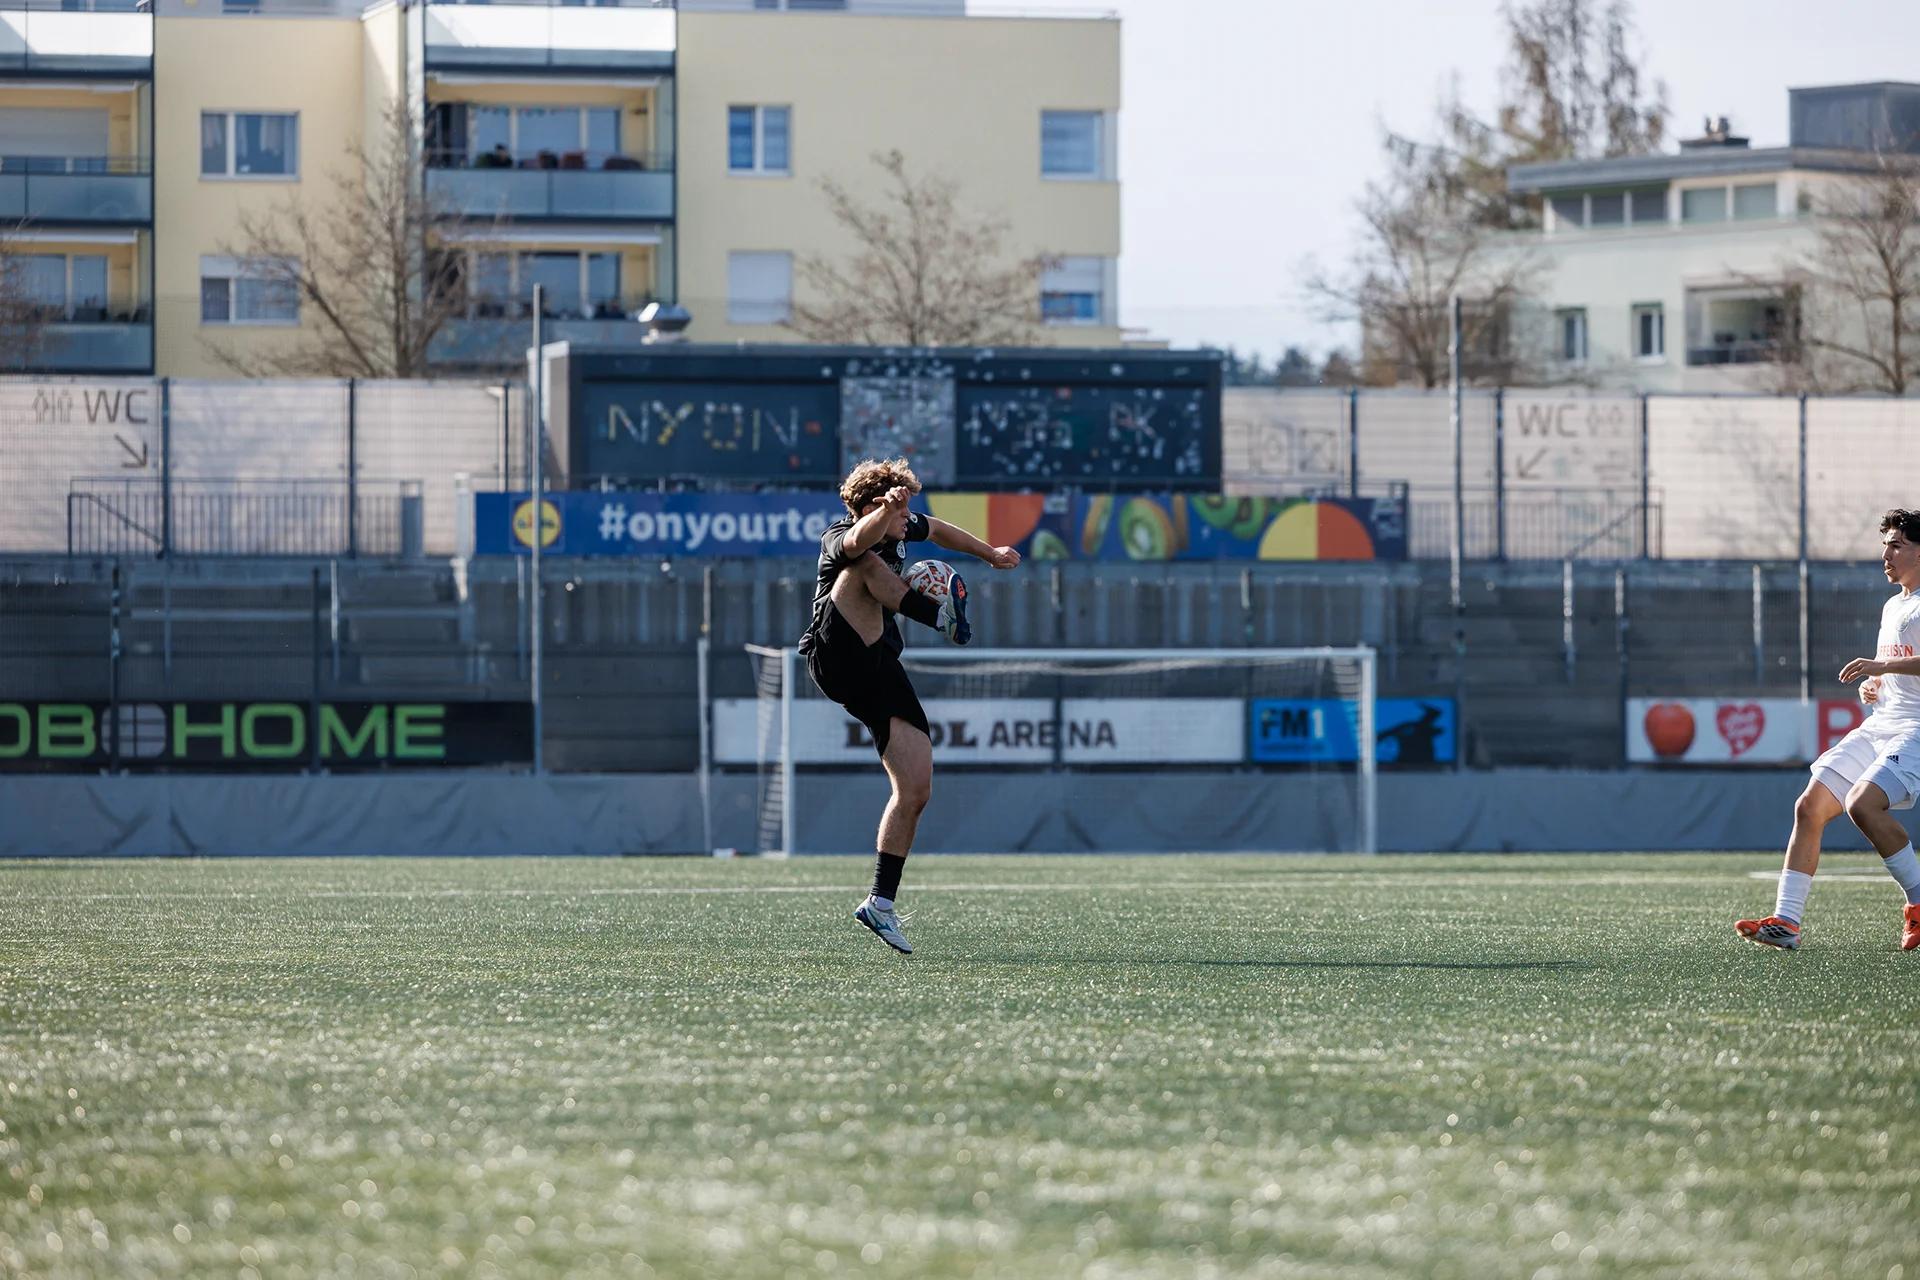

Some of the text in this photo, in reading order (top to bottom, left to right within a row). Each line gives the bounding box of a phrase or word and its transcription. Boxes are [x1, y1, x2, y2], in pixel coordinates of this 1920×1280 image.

[84, 389, 148, 424] WC
[1516, 404, 1579, 437] WC
[599, 504, 843, 549] #onyourte
[173, 704, 446, 758] HOME
[845, 719, 1116, 748] LL ARENA
[1260, 708, 1326, 740] FM1
